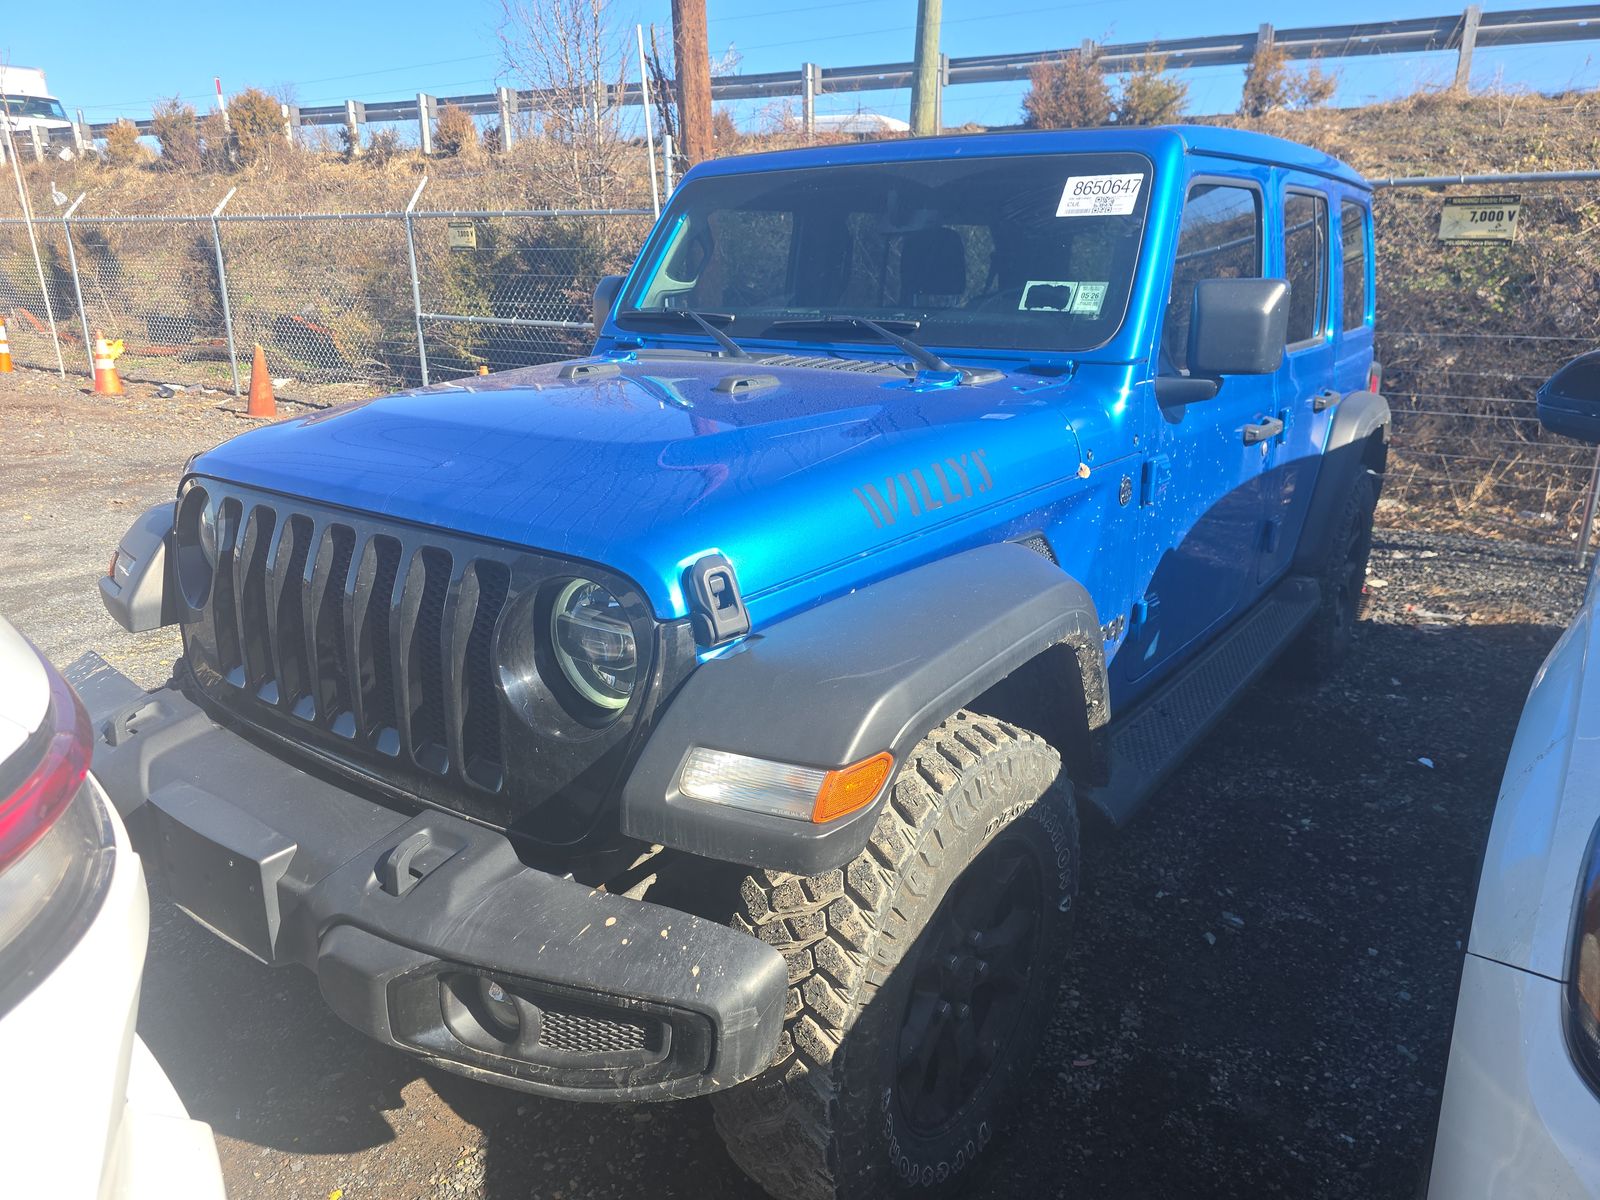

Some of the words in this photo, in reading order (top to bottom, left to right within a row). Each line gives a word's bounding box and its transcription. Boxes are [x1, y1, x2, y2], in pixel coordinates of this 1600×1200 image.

[1073, 179, 1142, 196] 8650647
[1470, 211, 1504, 224] 7,000
[1508, 210, 1517, 222] V
[852, 448, 993, 529] WILLYS
